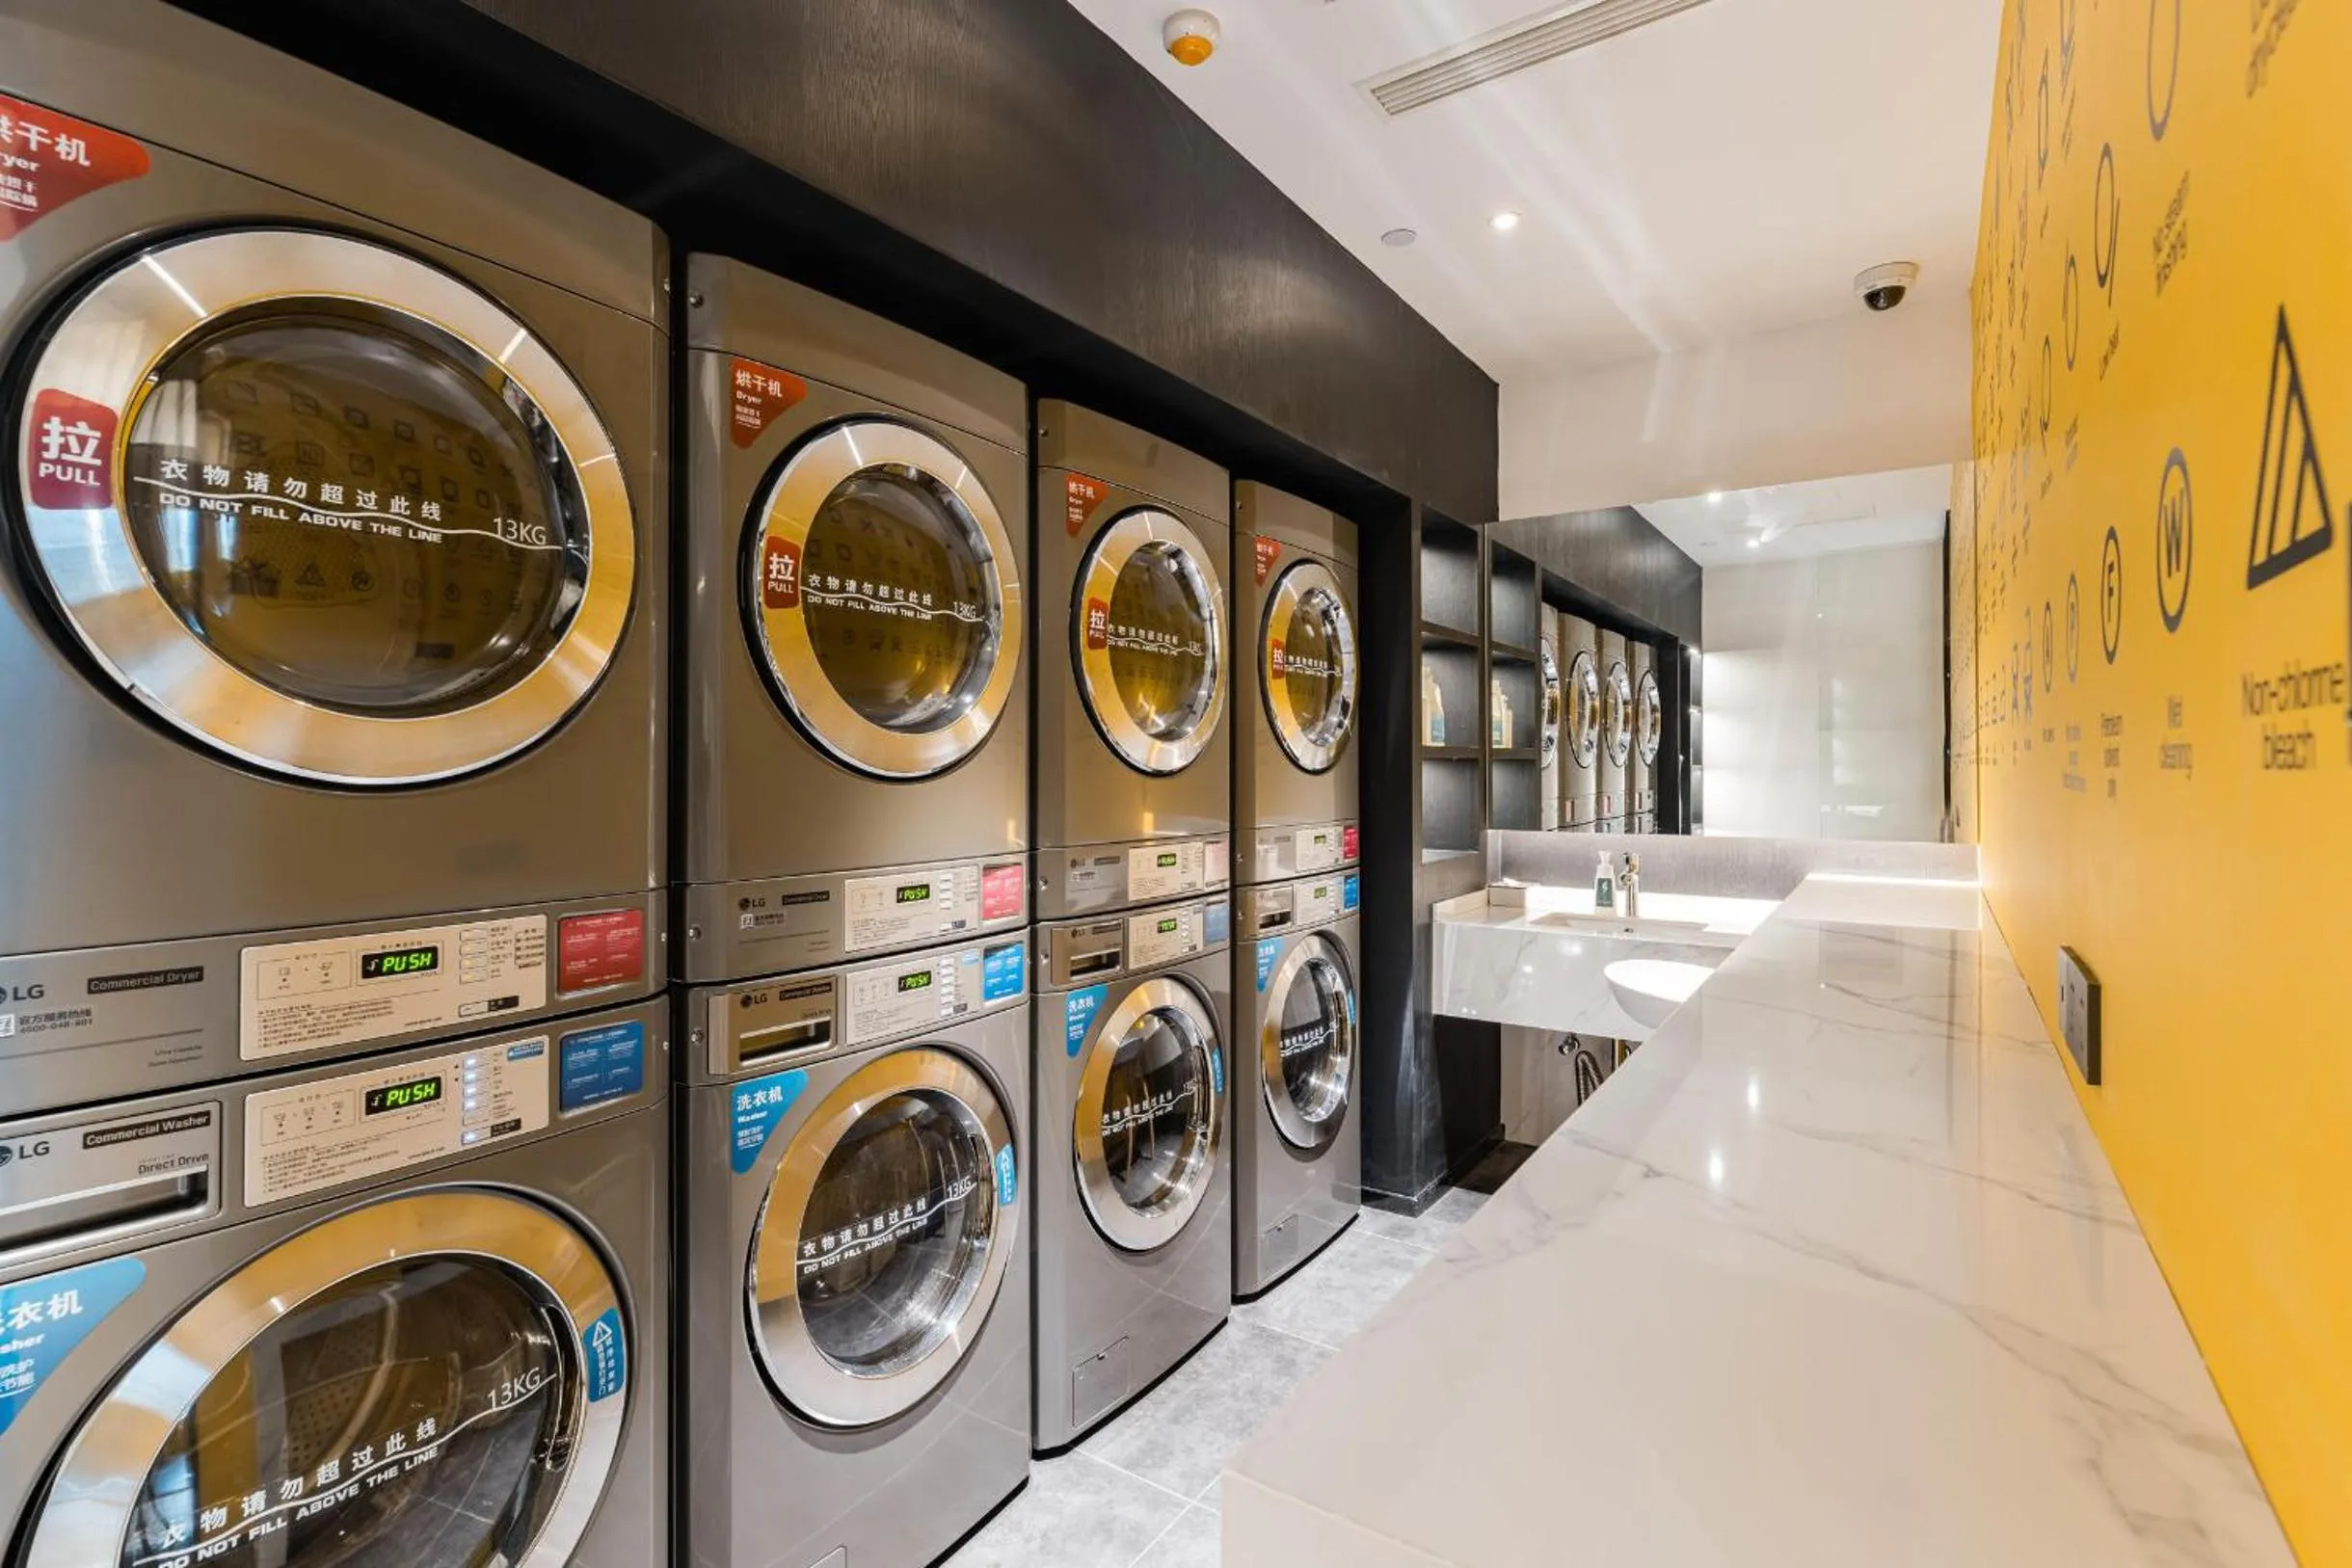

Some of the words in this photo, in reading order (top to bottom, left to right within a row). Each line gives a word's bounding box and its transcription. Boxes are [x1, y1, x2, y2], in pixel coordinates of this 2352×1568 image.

[0, 152, 40, 172] yer
[735, 368, 783, 397] 烘干机
[41, 416, 102, 466] 拉
[39, 462, 101, 487] PULL
[160, 458, 442, 521] 衣物请勿超过此线
[159, 492, 191, 508] DO
[199, 497, 243, 514] NOT
[251, 505, 290, 520] FILL
[298, 514, 362, 531] ABOVE
[369, 521, 402, 537] THE
[408, 528, 443, 544] LINE
[493, 517, 548, 546] 13KG
[769, 552, 794, 581] 拉
[767, 580, 794, 594] PULL
[1090, 608, 1105, 629] 拉
[752, 897, 766, 908] LG
[382, 952, 433, 972] PUSH
[12, 984, 45, 1001] LG
[90, 973, 165, 992] Commercial
[167, 970, 201, 983] Dryer
[754, 993, 768, 1004] LG
[386, 1082, 436, 1107] PUSH
[736, 1085, 784, 1111] 洗衣机
[86, 1123, 160, 1146] Commercial
[162, 1115, 209, 1131] Washer
[18, 1140, 50, 1159] LG
[138, 1158, 175, 1175] Direct
[177, 1153, 209, 1166] Drive
[803, 1263, 819, 1274] DO
[0, 1289, 84, 1337] 衣机
[0, 1333, 45, 1353] sher
[488, 1367, 542, 1411] 13KG
[161, 1417, 438, 1550] 衣物请勿超过此线
[197, 1533, 242, 1562] NOT
[248, 1516, 288, 1541] FILL
[296, 1485, 360, 1522] ABOVE
[365, 1465, 399, 1489] THE
[404, 1447, 439, 1472] LINE
